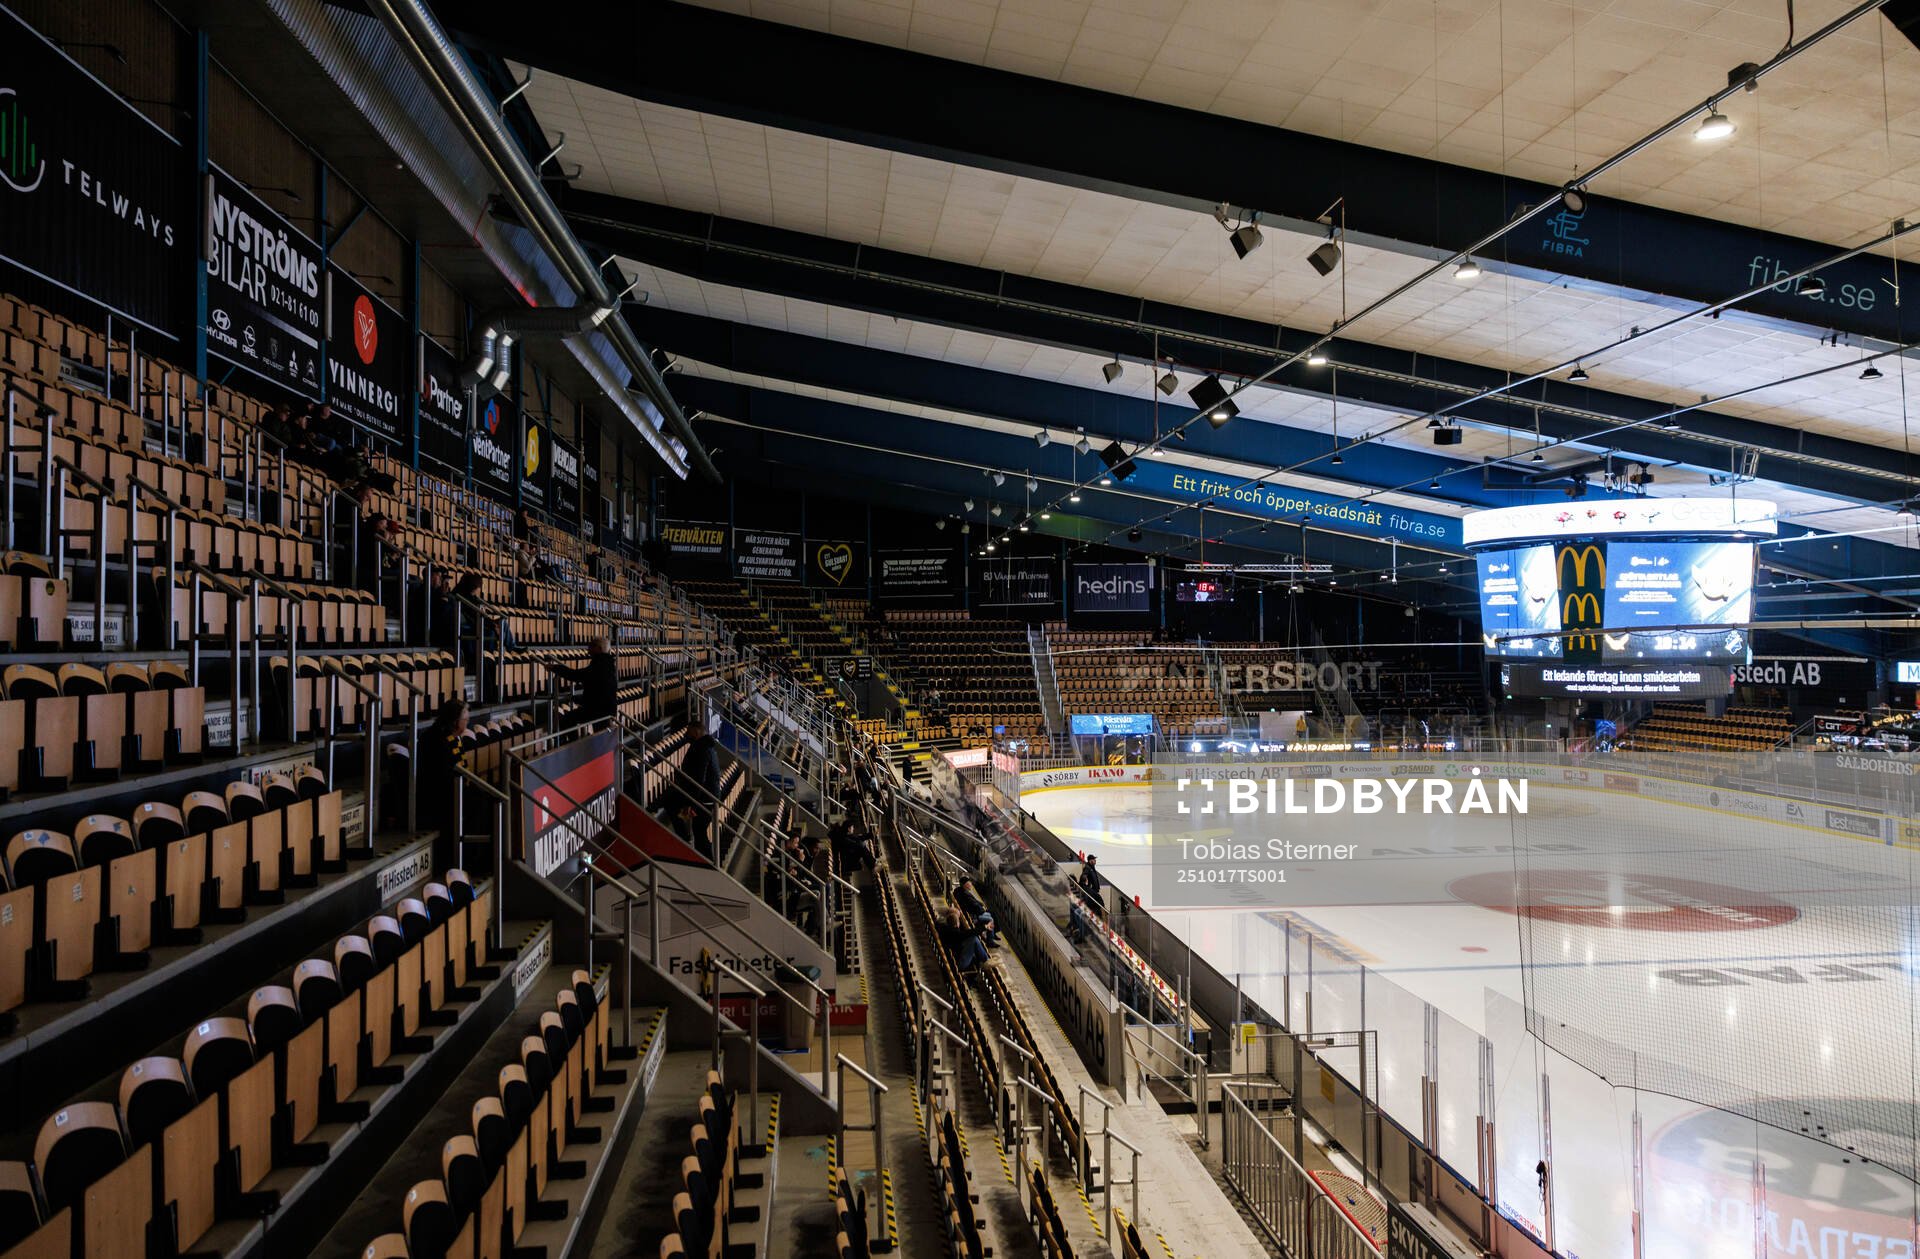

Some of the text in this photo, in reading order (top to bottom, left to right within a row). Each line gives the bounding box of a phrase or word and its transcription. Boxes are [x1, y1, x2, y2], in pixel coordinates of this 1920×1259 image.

[62, 158, 173, 247] TELWAYS
[210, 190, 318, 298] NYSTRÖMS
[1543, 239, 1583, 263] FIBRA
[207, 235, 266, 307] BILAR
[206, 325, 237, 348] HYUNDAI
[329, 357, 398, 416] VINNERGI
[1173, 474, 1446, 539] Ett fritt och öppet stadsnät fibra.se
[1078, 575, 1146, 594] hedins
[1792, 662, 1821, 687] AB
[1088, 768, 1124, 779] IKANO
[1408, 764, 1436, 775] SMIDE
[1493, 766, 1546, 777] RECYCLING
[389, 853, 429, 891] Hisstech AB
[1086, 998, 1105, 1068] AB
